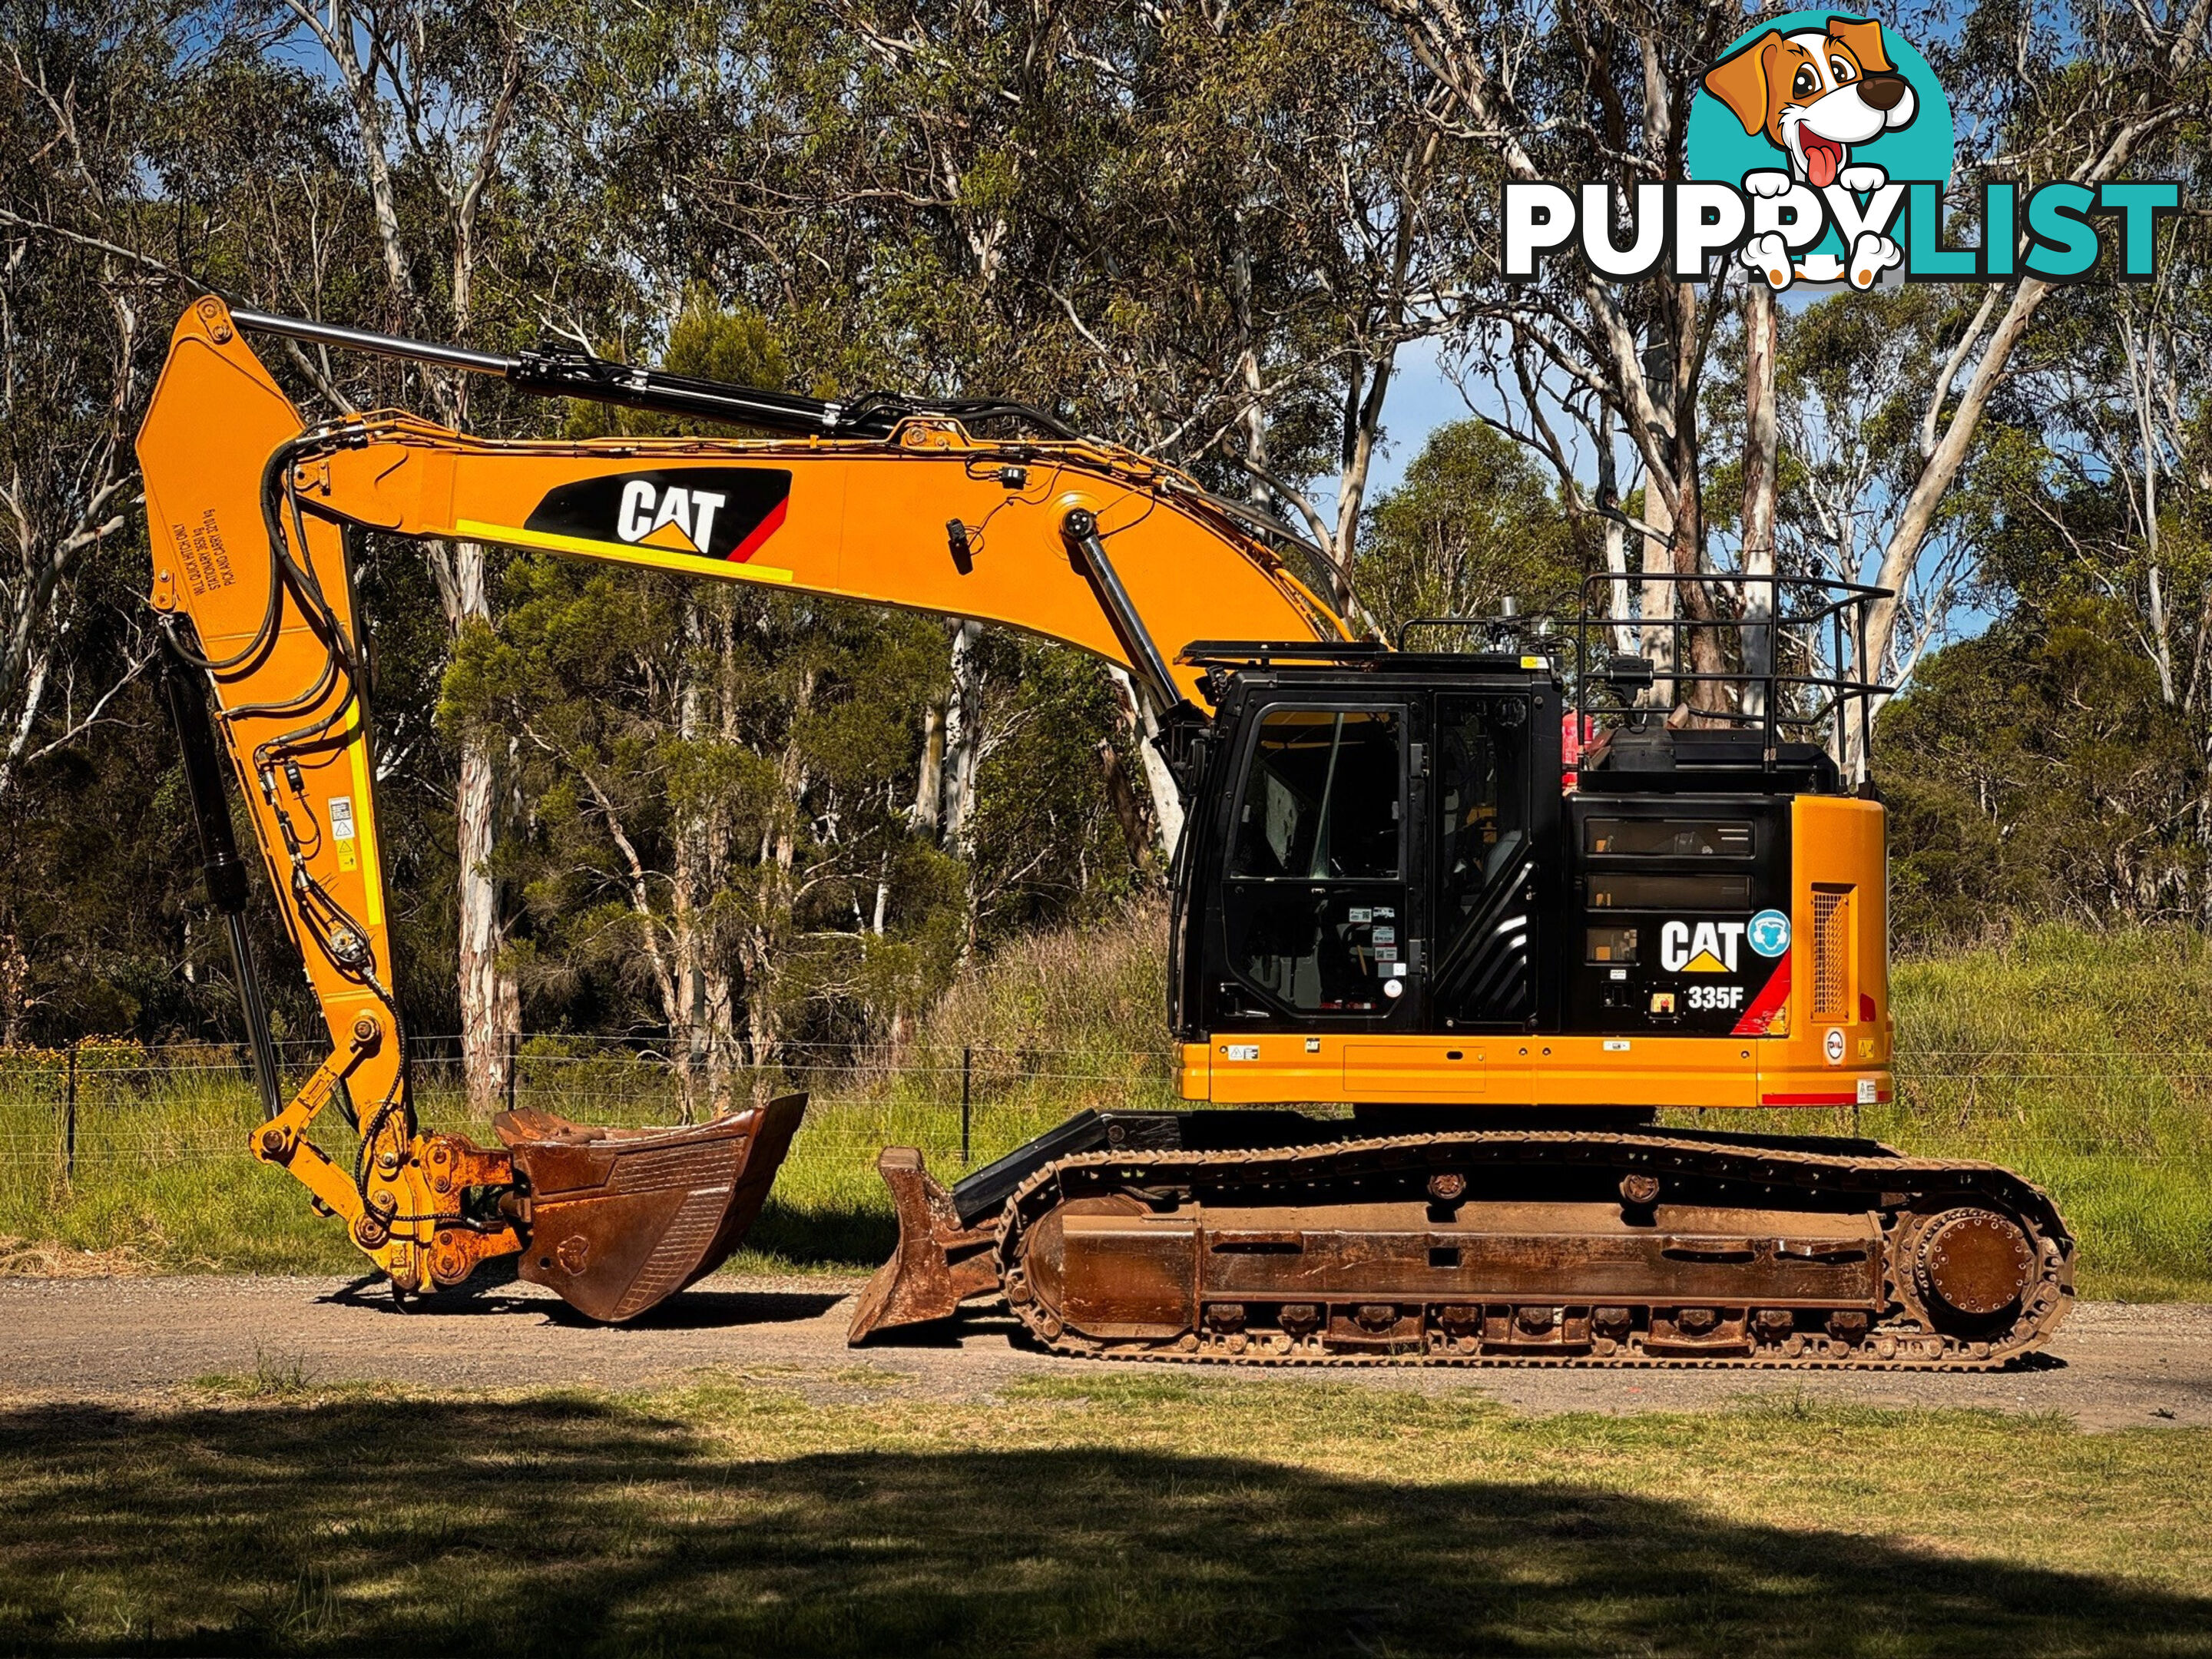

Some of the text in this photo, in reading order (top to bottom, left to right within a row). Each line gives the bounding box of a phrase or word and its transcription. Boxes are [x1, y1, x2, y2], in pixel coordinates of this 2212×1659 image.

[203, 508, 215, 518] kg
[617, 479, 726, 554] CAT
[172, 523, 188, 541] ONLY
[192, 527, 205, 538] kg
[178, 539, 194, 561] HITCH
[208, 534, 226, 555] CARRY
[184, 559, 201, 581] QUICK
[197, 551, 221, 591] STATIONARY
[216, 555, 231, 570] AND
[220, 569, 236, 586] PICK
[1661, 921, 1745, 972] CAT
[1688, 986, 1743, 1008] 335F
